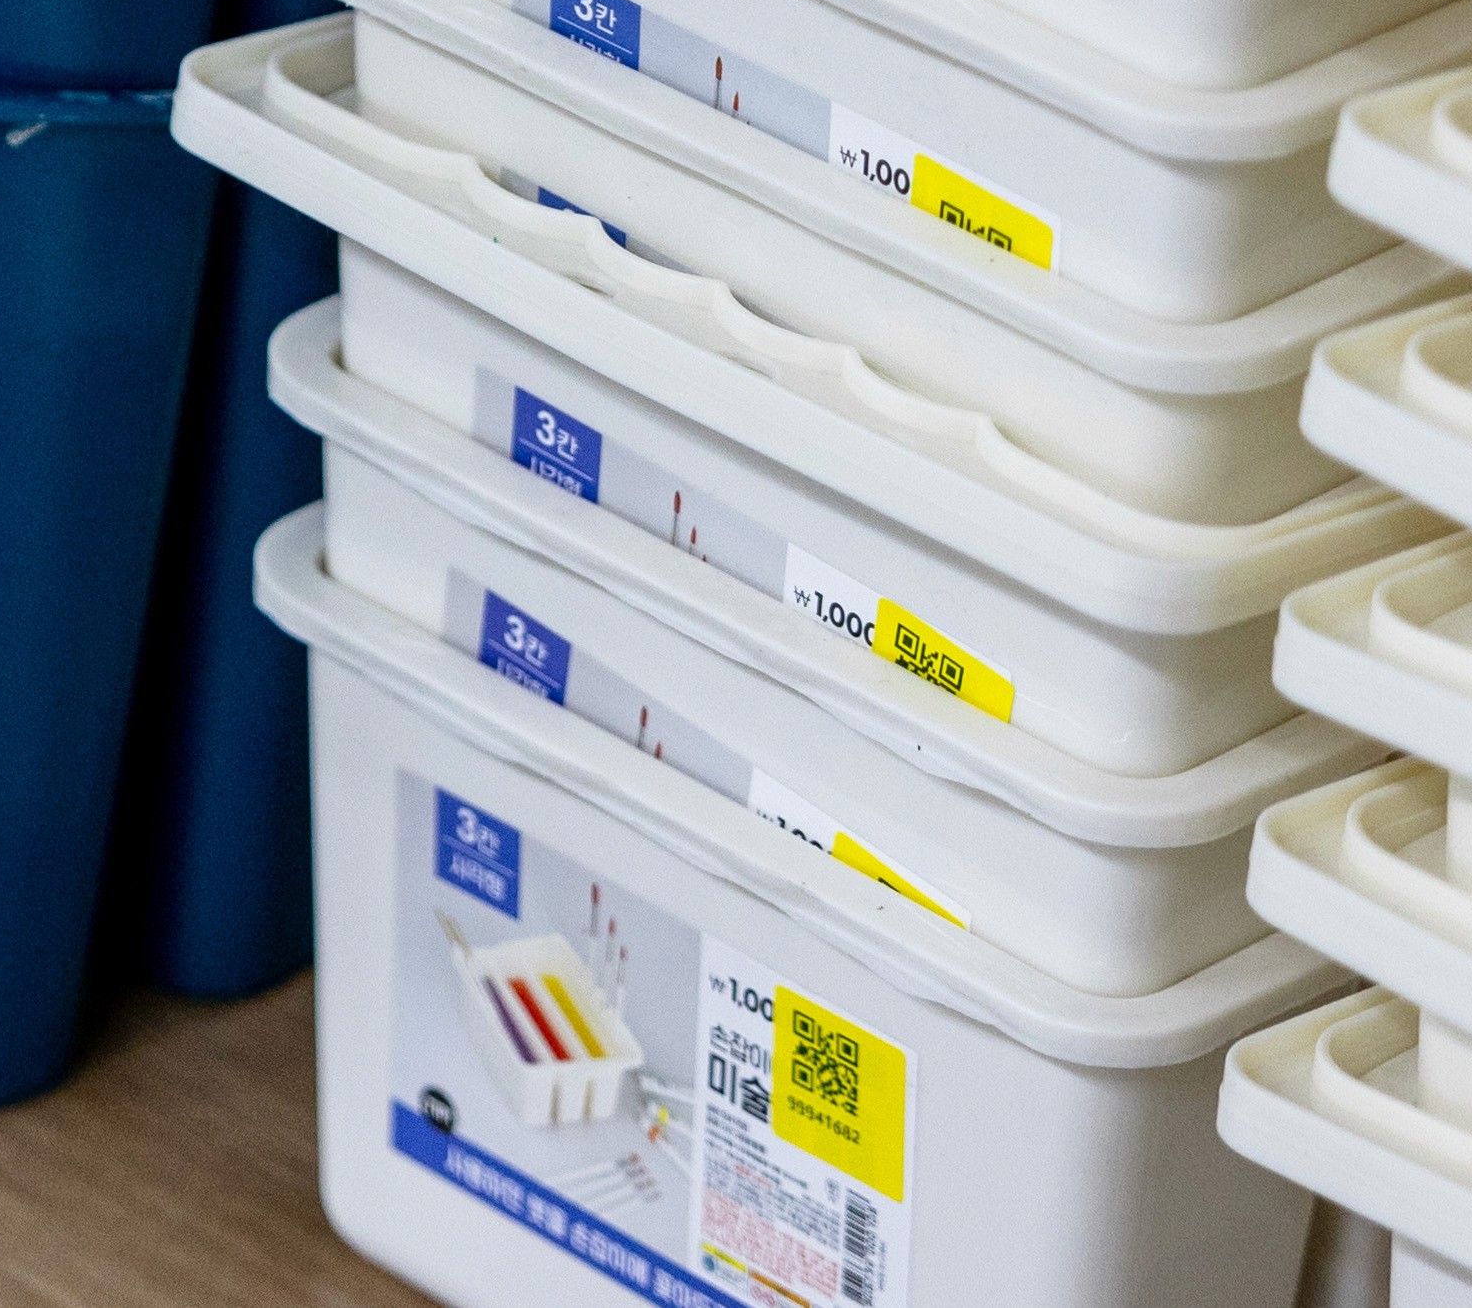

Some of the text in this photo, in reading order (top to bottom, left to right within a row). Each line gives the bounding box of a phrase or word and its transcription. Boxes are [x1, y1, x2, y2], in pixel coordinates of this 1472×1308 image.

[535, 410, 578, 462] 3칸
[503, 614, 548, 669] 3칸
[710, 1024, 772, 1075] 손잡이
